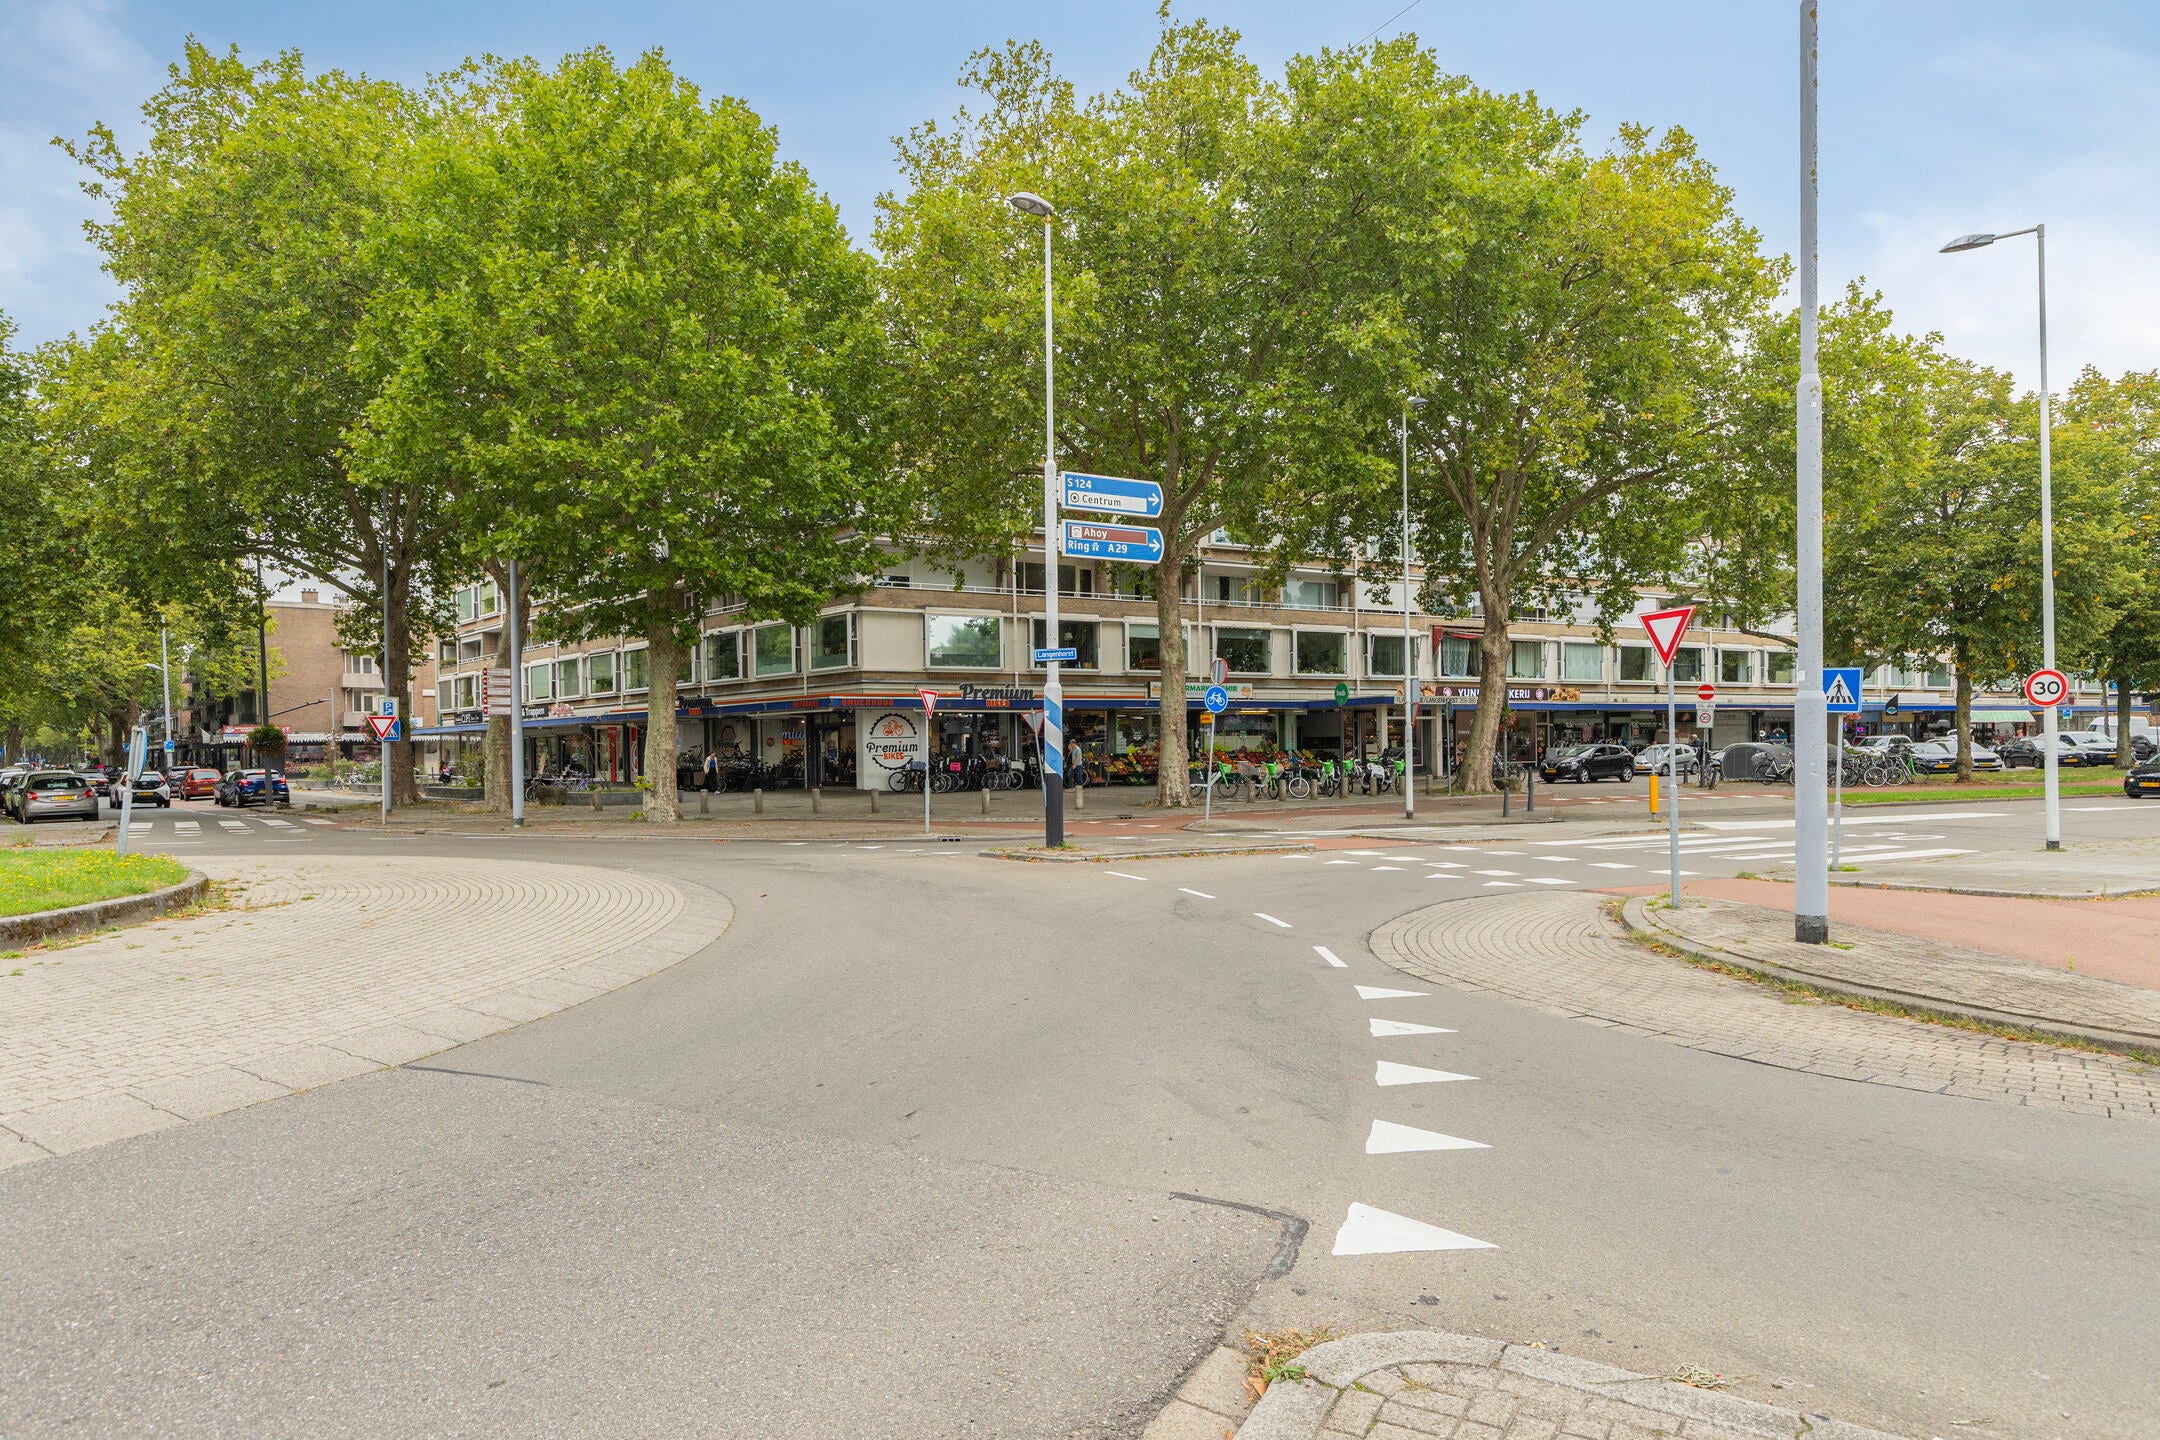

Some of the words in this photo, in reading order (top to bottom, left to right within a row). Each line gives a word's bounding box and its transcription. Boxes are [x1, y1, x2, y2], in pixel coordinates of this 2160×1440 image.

[1067, 478, 1073, 487] S
[1075, 479, 1092, 489] 124
[1082, 494, 1121, 507] Centrum
[1083, 528, 1107, 539] Ahoy
[1068, 540, 1090, 552] Ring
[1037, 650, 1075, 659] Langenhorst
[959, 683, 1035, 700] Premium
[2034, 681, 2060, 695] 30
[841, 698, 894, 707] ONDERHOUD
[986, 699, 1010, 708] BIKES
[866, 740, 918, 753] Premium
[883, 752, 905, 760] BIKES
